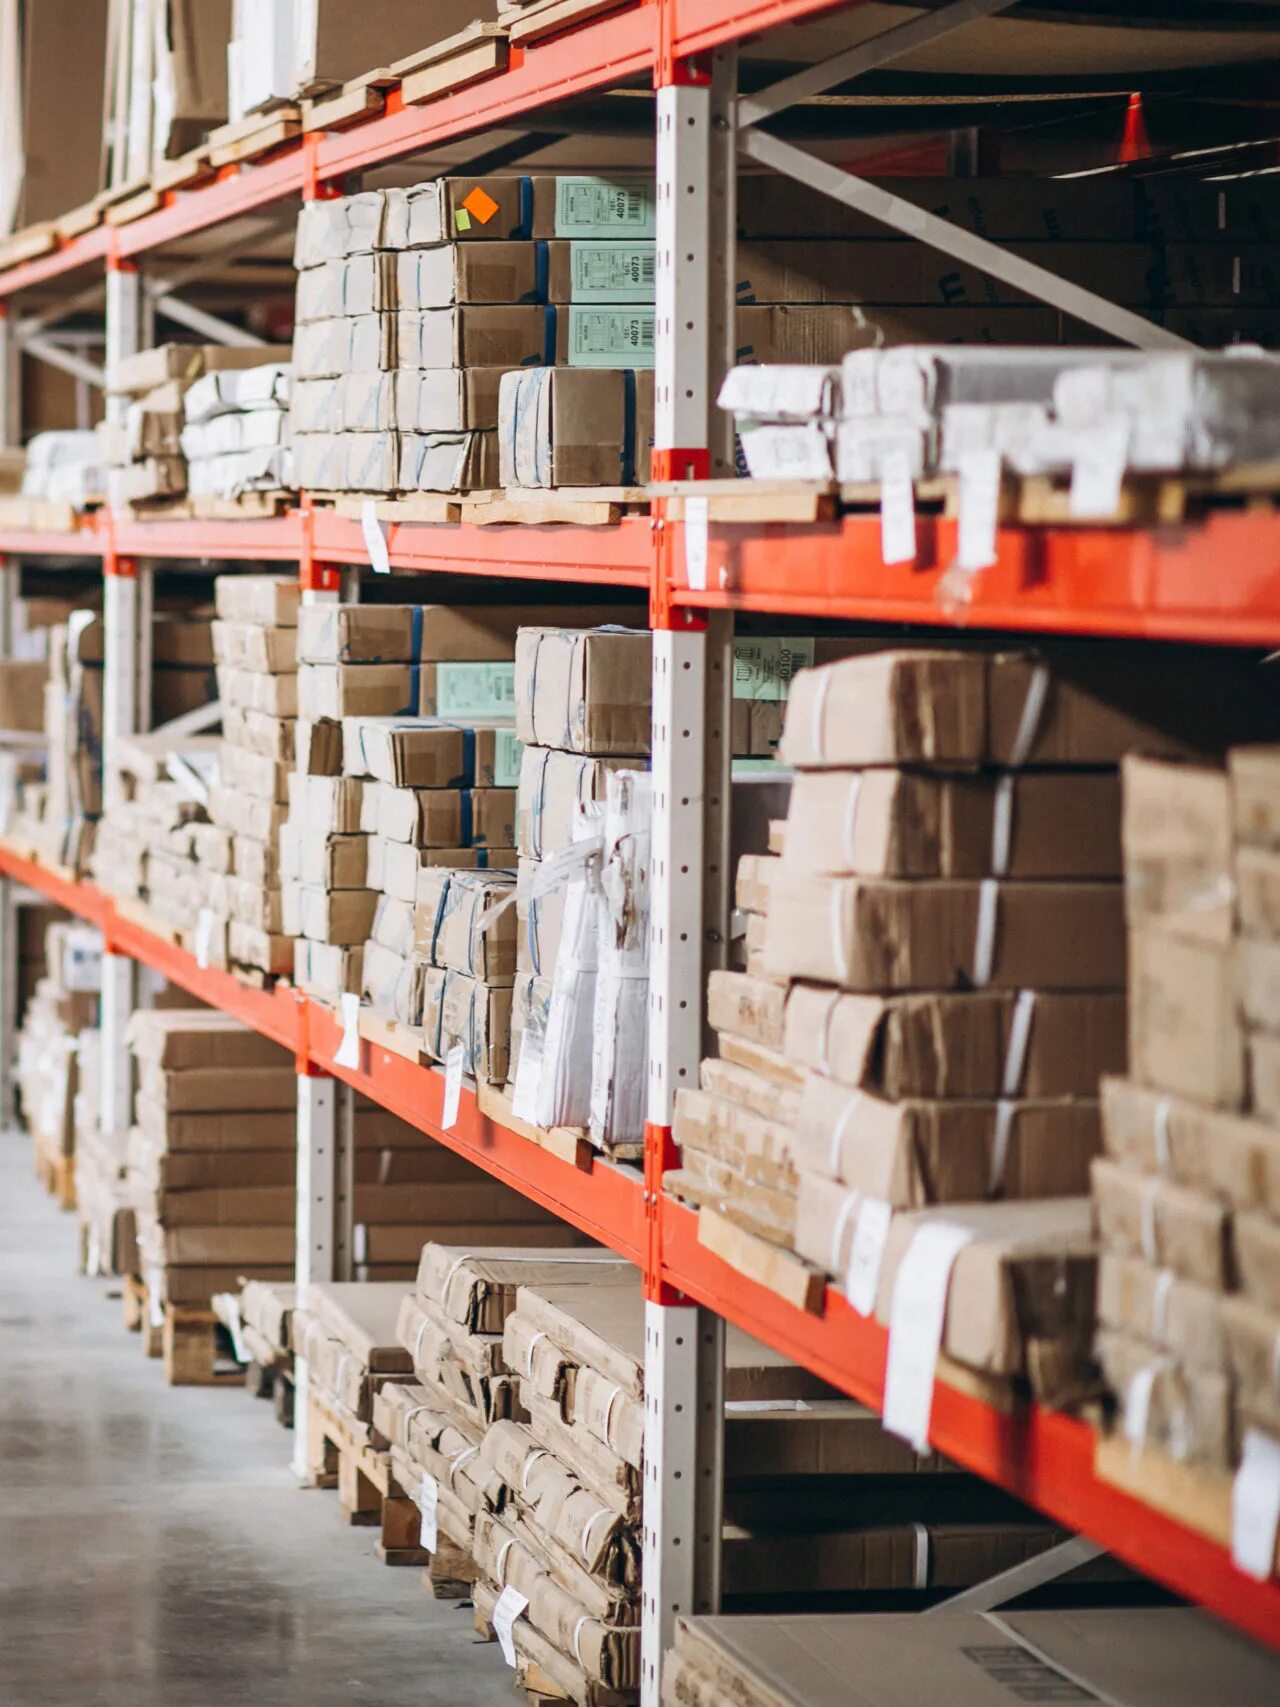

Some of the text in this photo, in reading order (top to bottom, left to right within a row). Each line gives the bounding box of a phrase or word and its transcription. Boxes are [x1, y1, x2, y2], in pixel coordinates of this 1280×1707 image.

[616, 191, 625, 218] 40073
[631, 256, 640, 283] 40073
[630, 319, 639, 347] 40073
